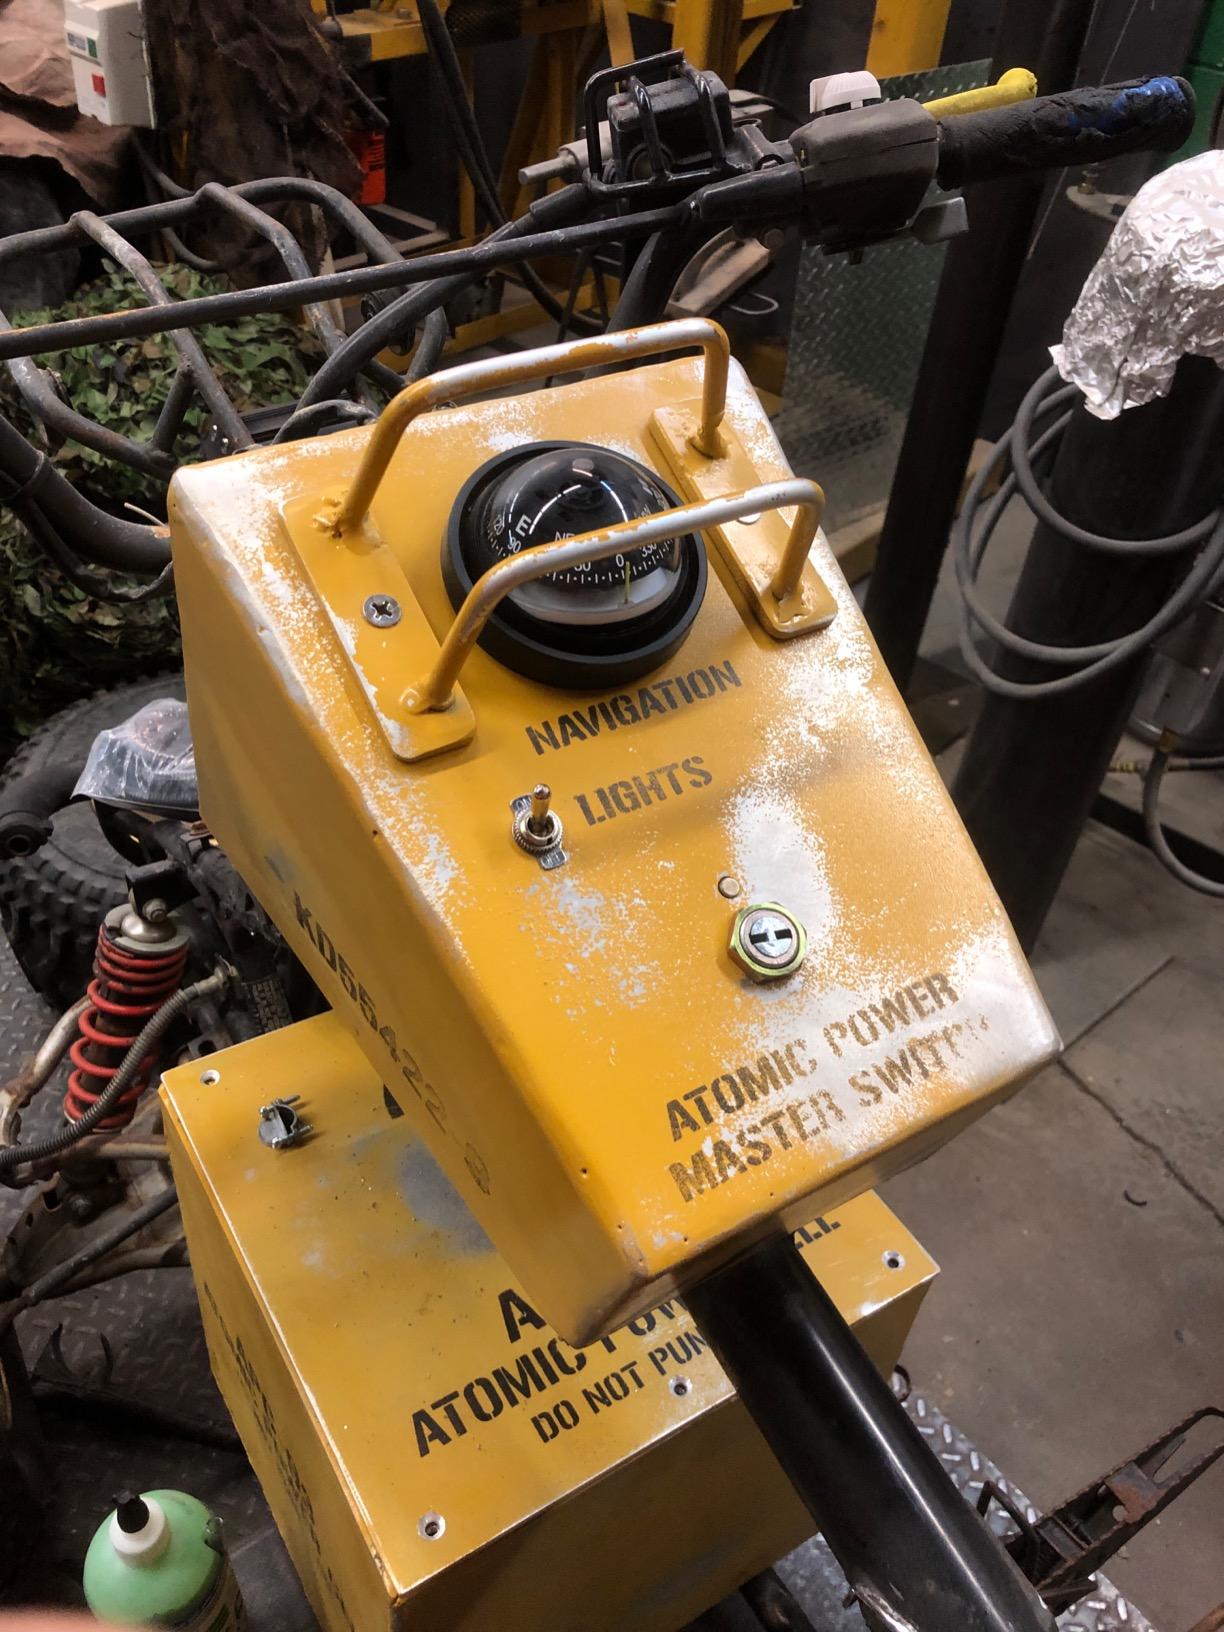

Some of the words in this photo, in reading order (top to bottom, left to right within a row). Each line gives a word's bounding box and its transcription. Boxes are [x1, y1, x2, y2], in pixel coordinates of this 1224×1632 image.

[515, 514, 532, 537] E
[615, 553, 625, 567] 0
[525, 660, 742, 756] NAVIGATION
[573, 755, 713, 826] LIGHTS
[666, 1038, 818, 1142] ATOMIC
[822, 972, 960, 1058] POWER
[668, 1088, 846, 1204] MASTER
[412, 1337, 587, 1458] ATOMIC
[531, 1399, 580, 1444] DO
[581, 1360, 645, 1414] NOT
